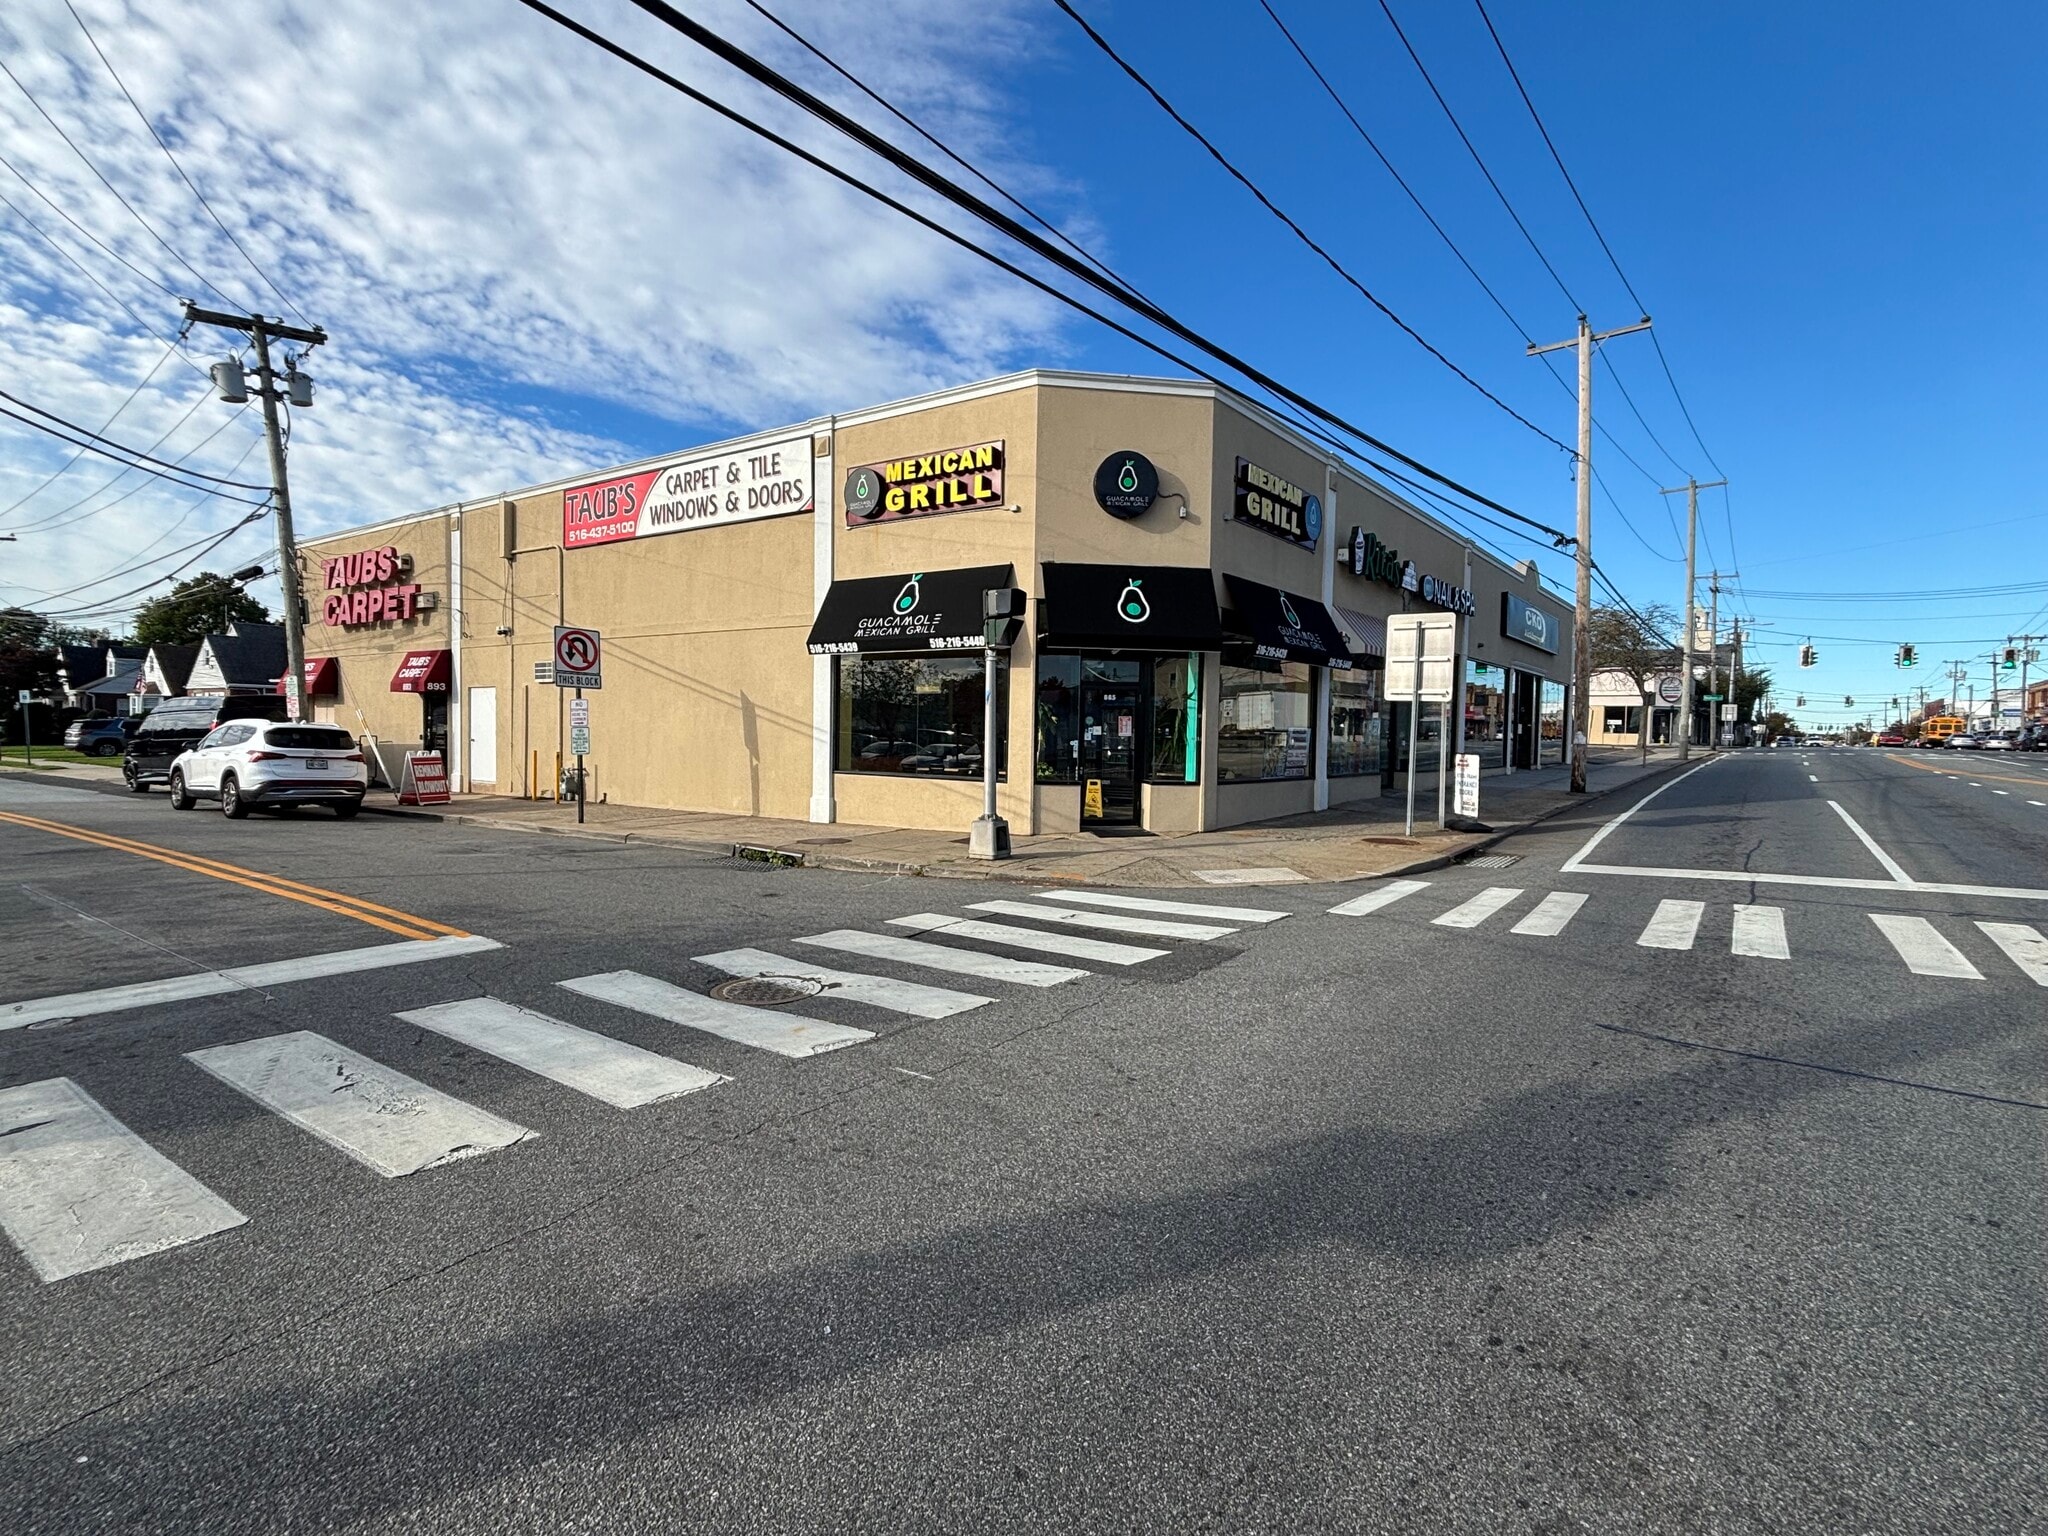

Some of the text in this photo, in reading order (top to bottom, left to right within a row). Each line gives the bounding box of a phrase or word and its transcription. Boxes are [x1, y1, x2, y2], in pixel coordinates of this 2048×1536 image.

[665, 452, 782, 496] CARPET & TILE
[885, 445, 993, 483] MEXICAN
[566, 482, 637, 524] TAUB'S
[650, 478, 804, 526] WINDOWS & DOORS
[885, 474, 992, 512] GRILL
[1247, 463, 1303, 507] MEXICAN
[569, 521, 635, 541] 516-437-5100
[1247, 491, 1301, 535] GRILL
[321, 546, 396, 590] TAUBS
[323, 584, 418, 626] CARPET
[1433, 577, 1475, 616] NAIL & SPA
[854, 625, 936, 637] MEXICAN GRILL
[858, 613, 943, 628] GUACAMOLE
[1278, 625, 1321, 643] GUACAMOLE
[1525, 610, 1542, 631] CKO
[809, 642, 858, 653] 516-216-5439
[399, 667, 428, 678] CARPET
[427, 682, 446, 691] 893
[559, 675, 599, 686] THIS BLOCK
